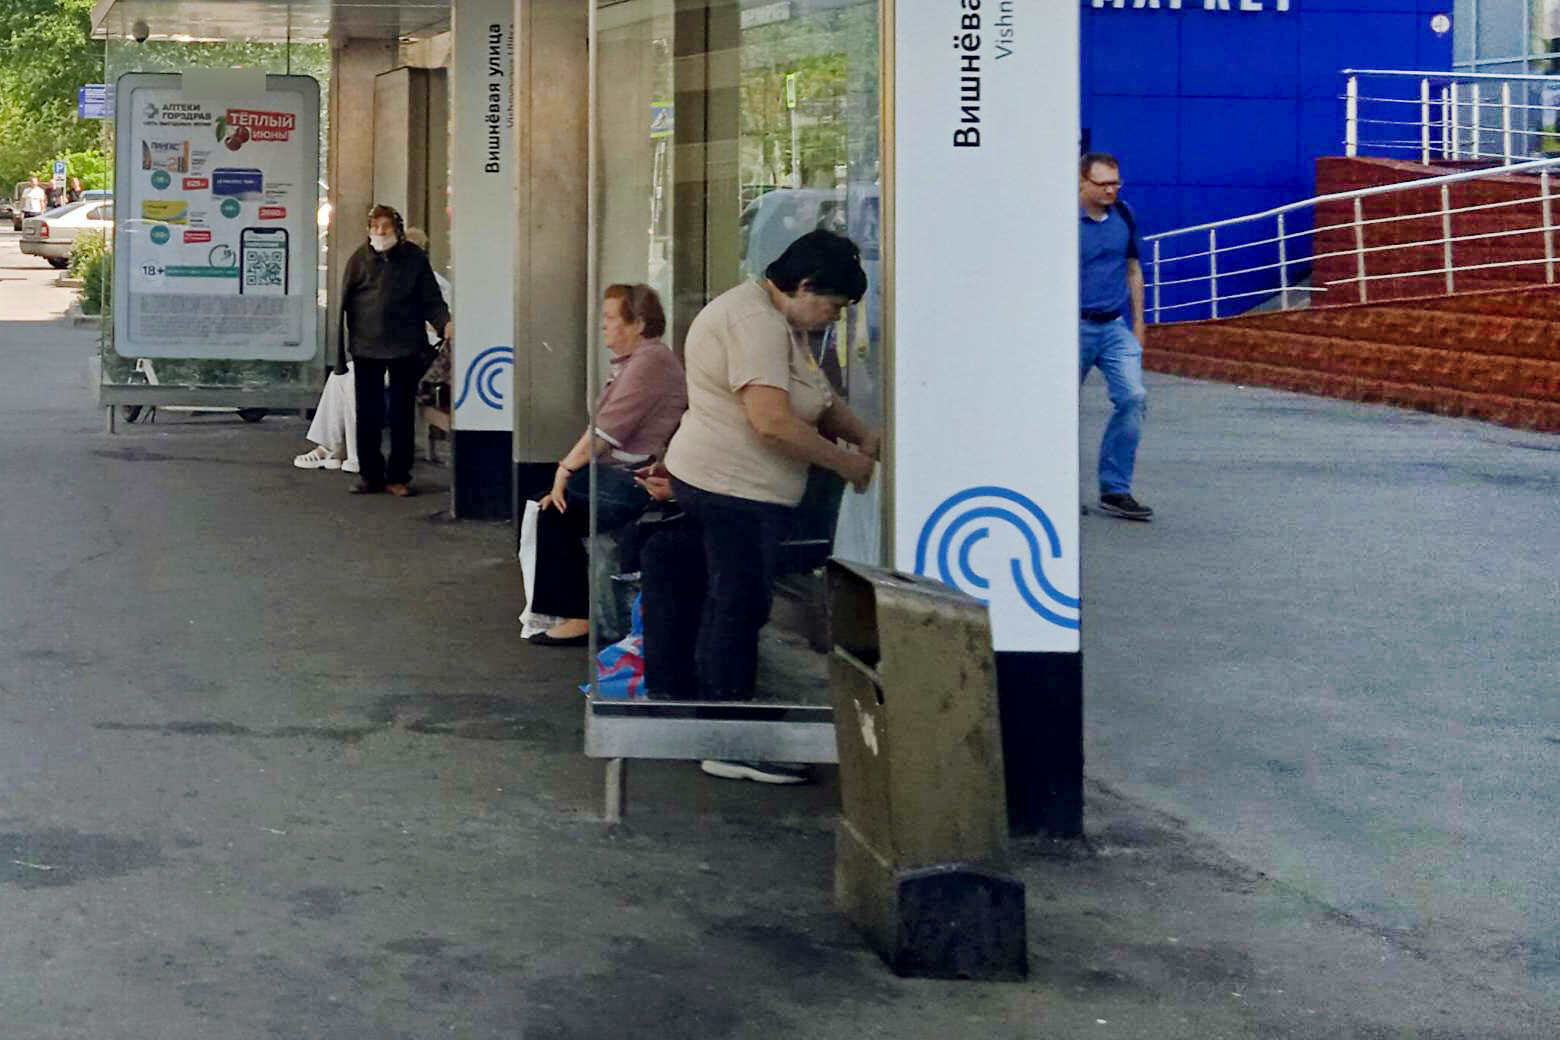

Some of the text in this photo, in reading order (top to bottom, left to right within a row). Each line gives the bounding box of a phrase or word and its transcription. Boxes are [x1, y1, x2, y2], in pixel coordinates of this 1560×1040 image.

[485, 24, 503, 173] Вишнёвая улица
[162, 103, 201, 111] АПТЕКИ
[162, 112, 212, 121] ГОРЗДРАВ
[229, 112, 294, 128] ТЁПЛЫЙ
[143, 265, 164, 277] 18+
